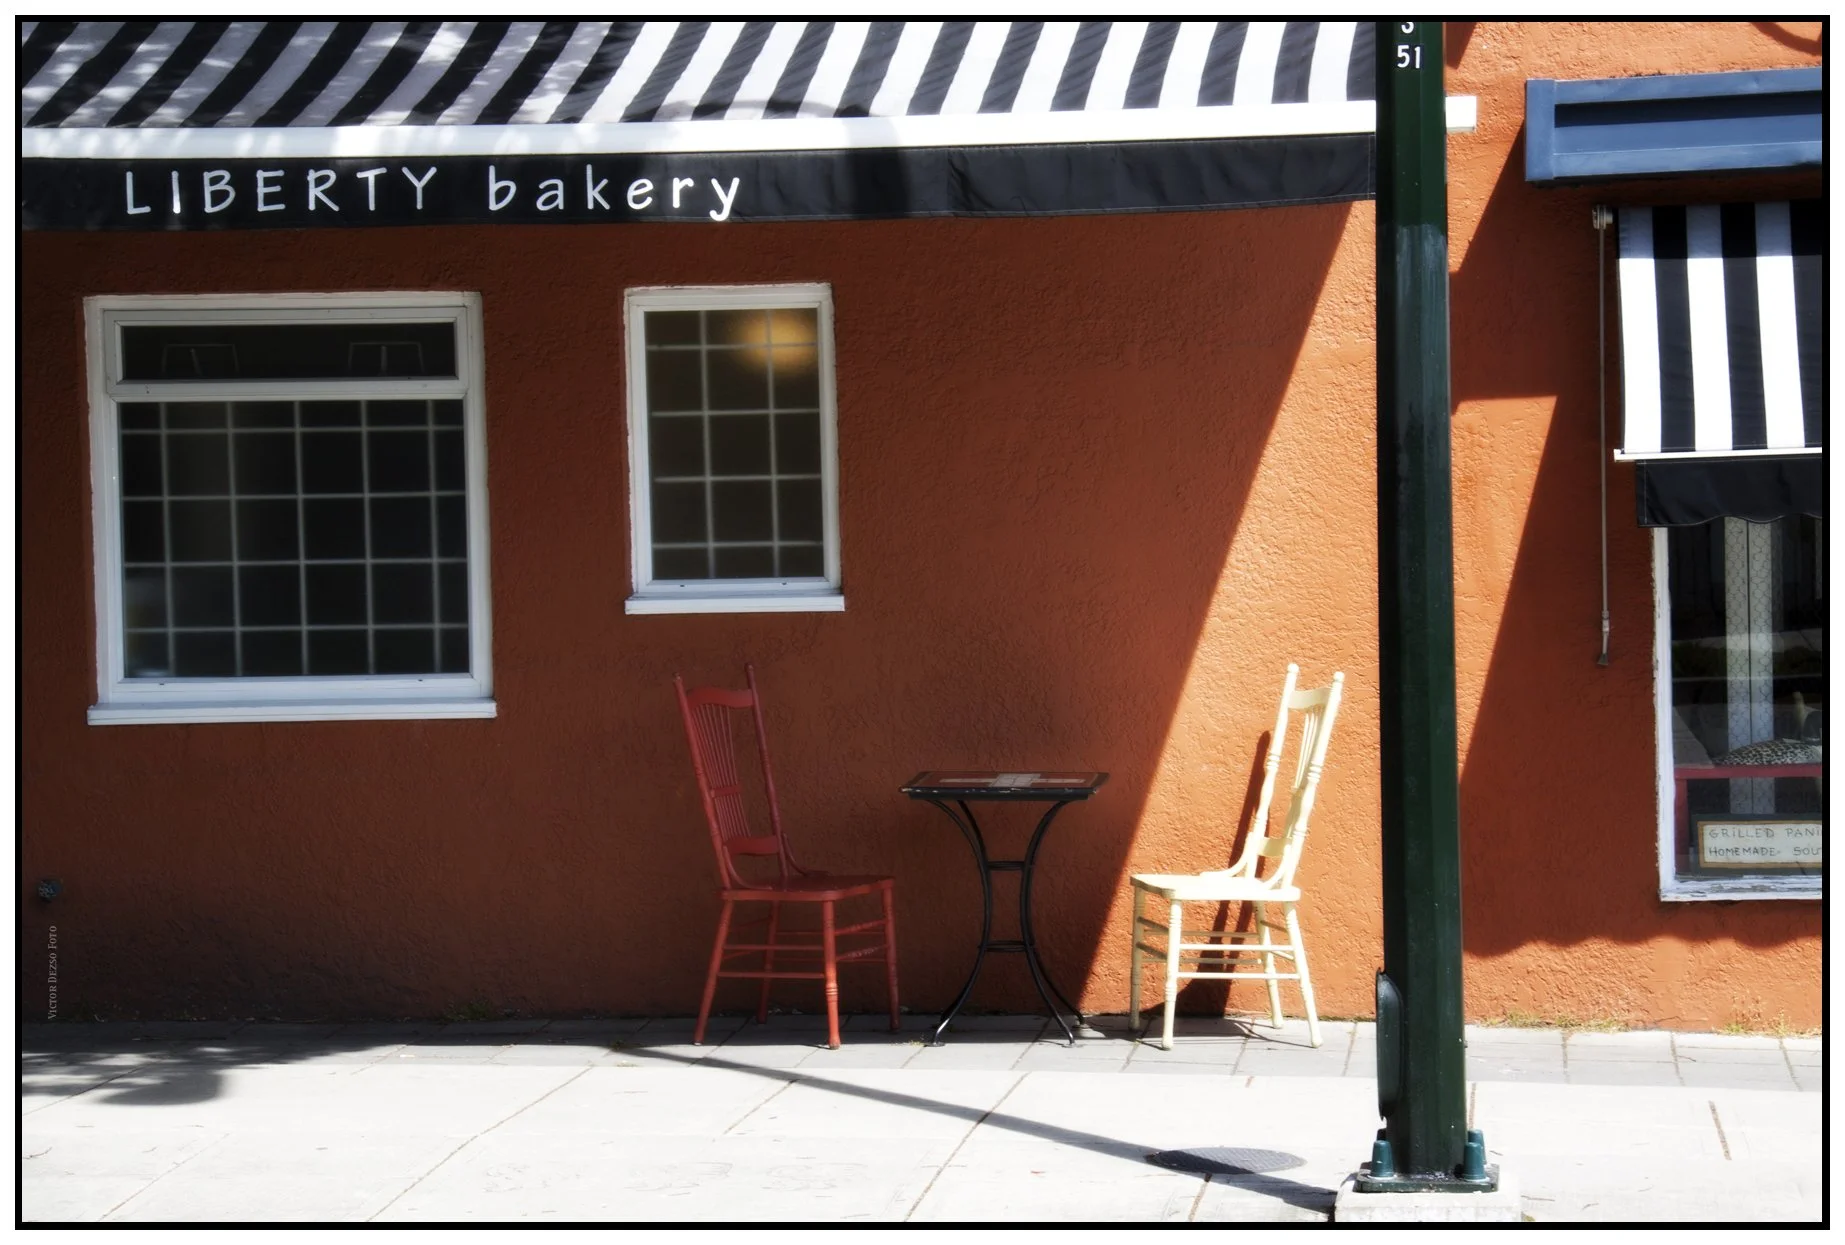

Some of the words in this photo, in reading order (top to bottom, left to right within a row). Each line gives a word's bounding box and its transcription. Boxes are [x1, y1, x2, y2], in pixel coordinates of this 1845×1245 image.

[1397, 44, 1421, 69] 51
[125, 165, 437, 215] LIBERTY
[488, 163, 740, 222] bakery
[1793, 846, 1821, 856] SOU
